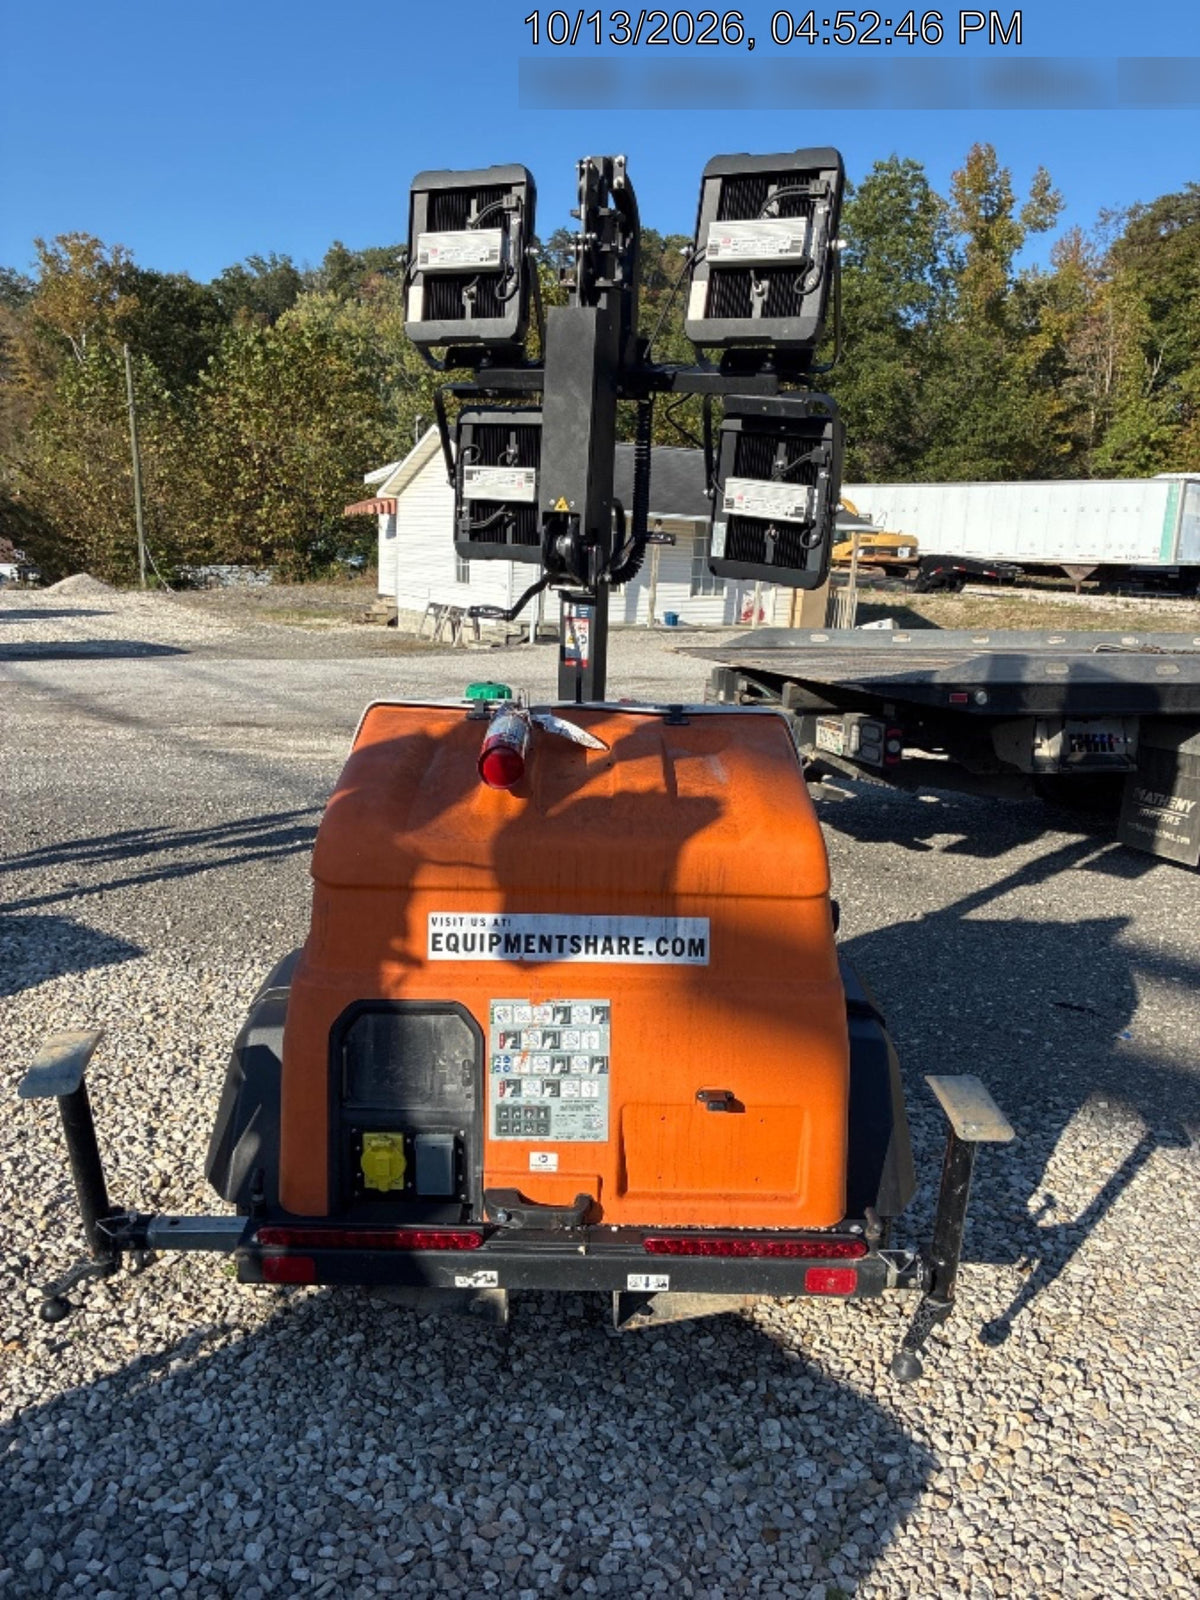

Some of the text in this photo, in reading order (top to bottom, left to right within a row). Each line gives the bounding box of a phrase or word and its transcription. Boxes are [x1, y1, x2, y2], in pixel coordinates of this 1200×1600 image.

[431, 917, 465, 927] VISIT
[471, 917, 487, 928] US
[431, 933, 705, 957] EQUIPMENTSHARE.COM
